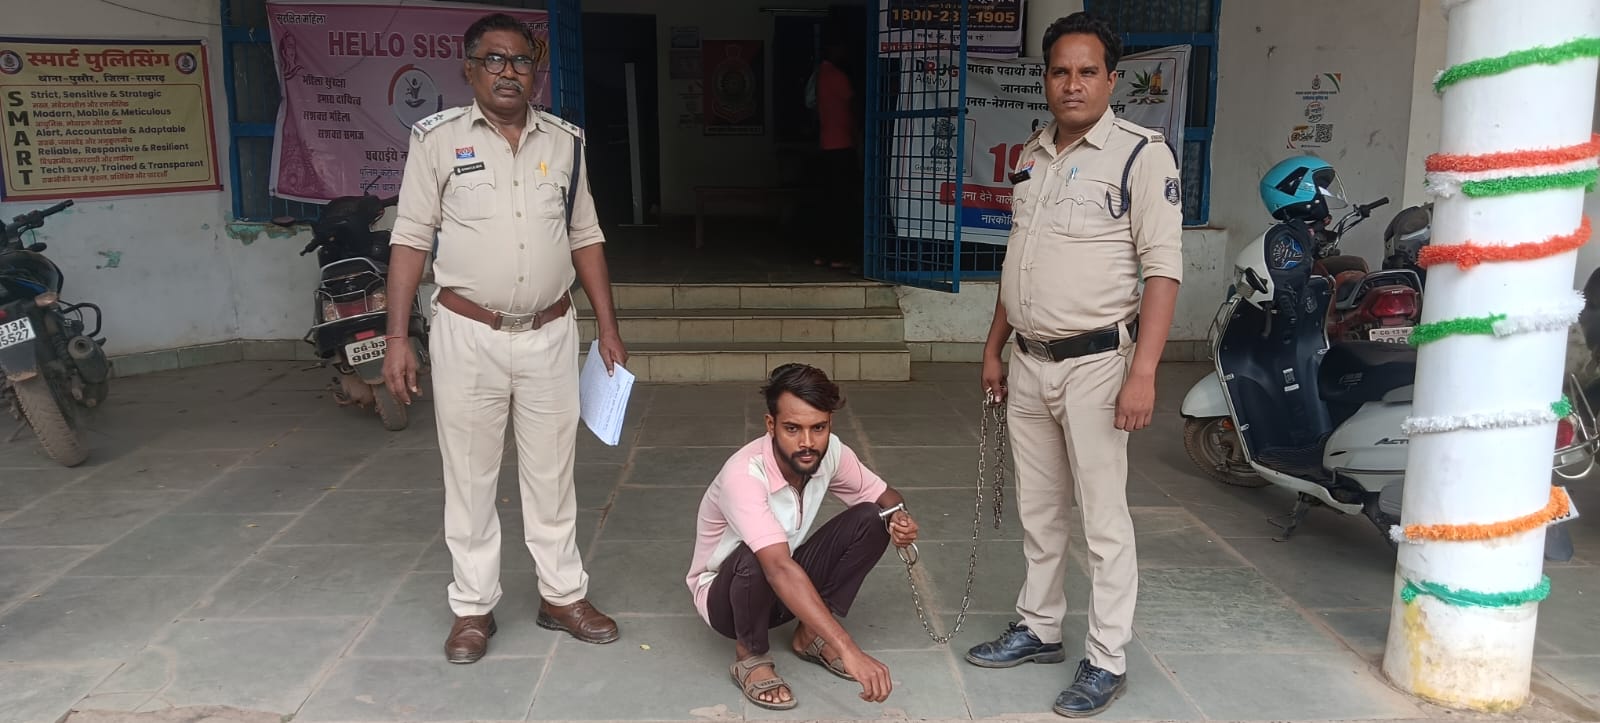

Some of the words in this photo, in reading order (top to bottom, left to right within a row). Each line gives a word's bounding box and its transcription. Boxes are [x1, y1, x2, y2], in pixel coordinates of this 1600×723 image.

[892, 9, 1017, 23] 1800-23-1905
[328, 31, 405, 57] HELLO
[413, 33, 465, 59] SIST
[26, 48, 80, 68] स्मार्ट
[1029, 64, 1043, 77] की
[915, 73, 947, 88] Ativty
[31, 90, 62, 99] Strict,
[63, 89, 108, 98] Sensitive
[119, 89, 162, 99] Strategic
[1000, 81, 1043, 95] जानकारी
[966, 96, 1024, 110] ानस-नेशनल
[32, 110, 75, 118] Modern,
[77, 108, 110, 117] Mobile
[121, 107, 171, 116] Meticulous
[36, 128, 63, 137] Alert,
[65, 126, 127, 136] Accountable
[138, 125, 186, 136] Adaptable
[38, 147, 81, 156] Reliable,
[84, 144, 140, 154] Responsive
[150, 143, 189, 152] Resilient
[40, 166, 65, 174] Tech
[67, 166, 99, 174] savvy,
[101, 162, 137, 171] Trained
[148, 160, 204, 170] Transparent
[0, 329, 29, 347] 5527
